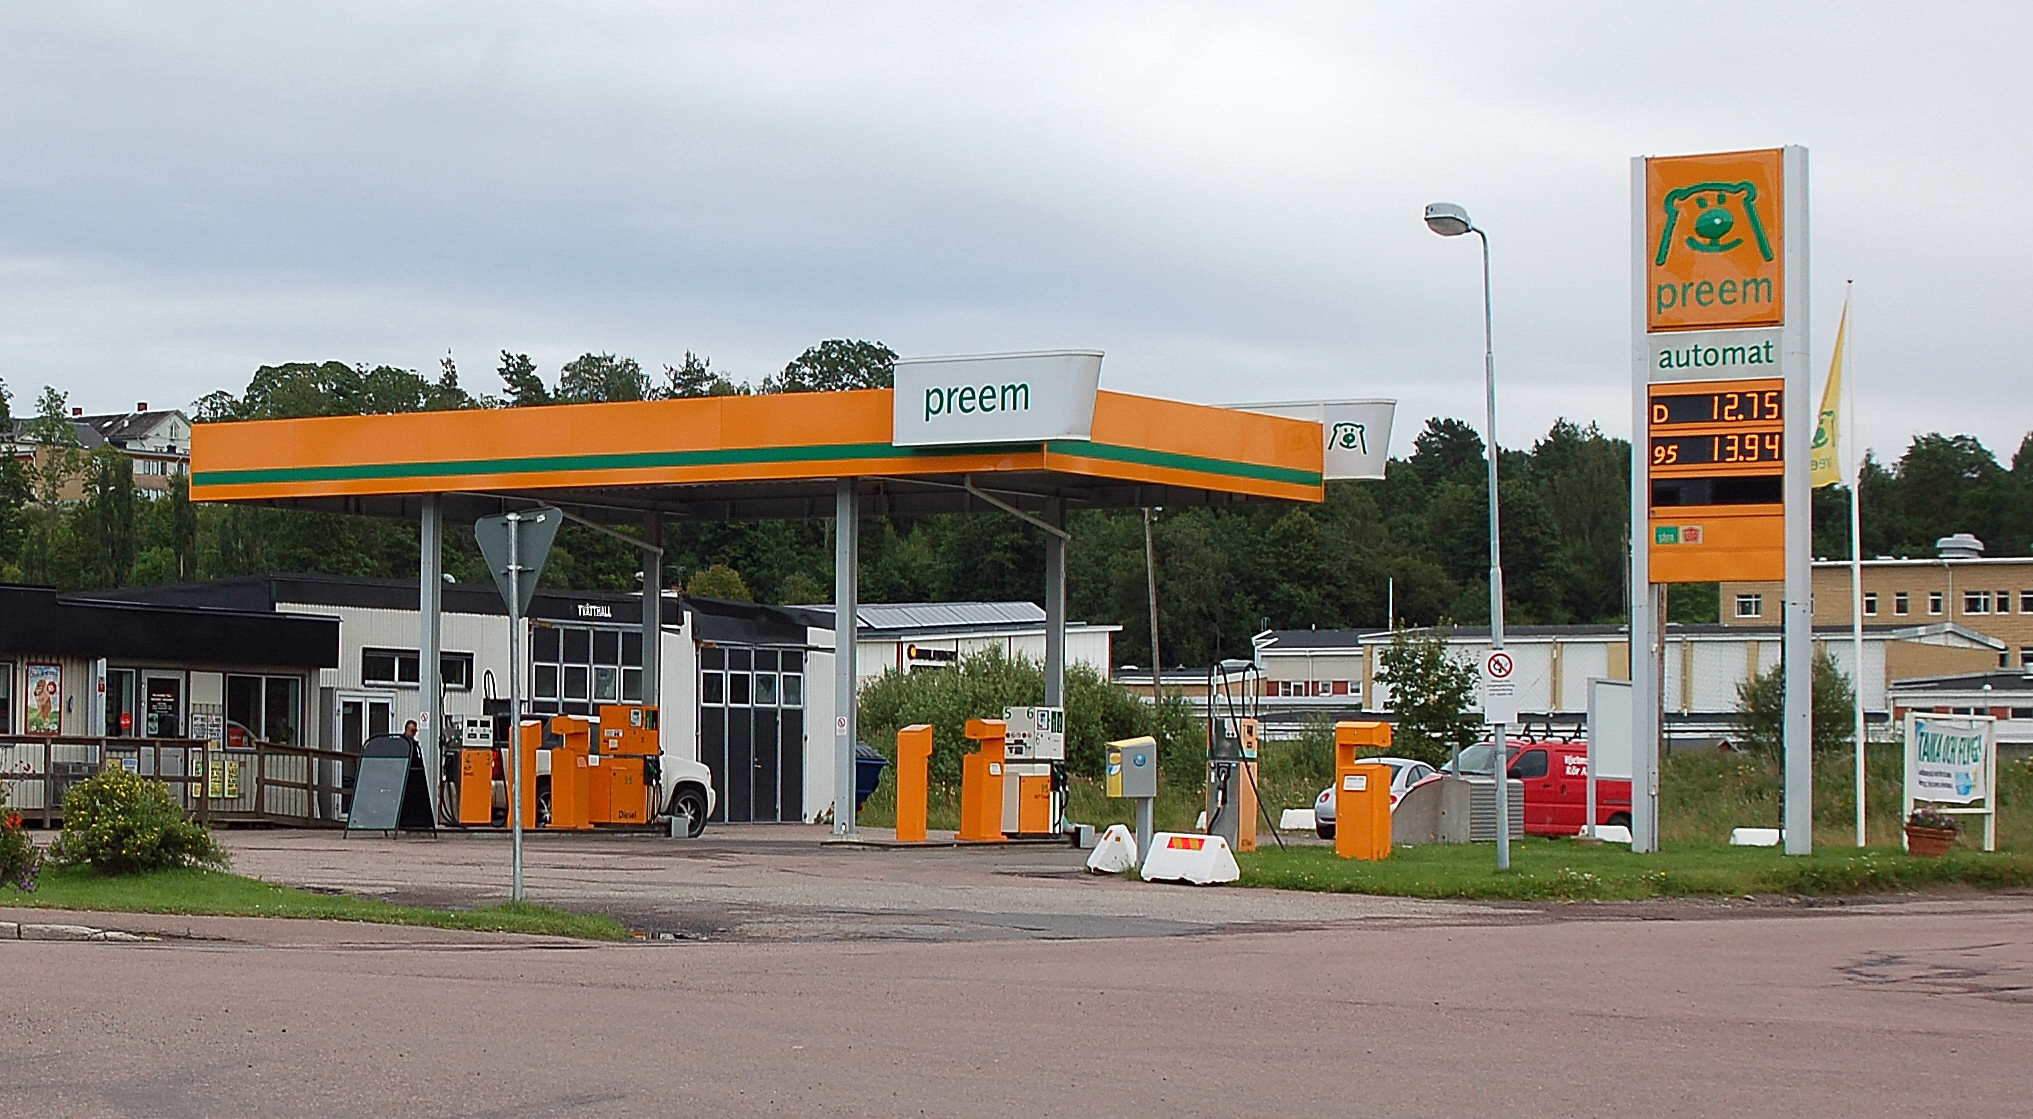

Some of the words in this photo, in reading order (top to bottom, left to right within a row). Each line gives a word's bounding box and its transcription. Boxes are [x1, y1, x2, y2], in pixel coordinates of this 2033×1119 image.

[1657, 278, 1772, 315] preem
[1659, 340, 1774, 368] automat
[925, 383, 1029, 422] preem
[1653, 404, 1669, 423] D
[1713, 391, 1779, 421] 12.75
[1653, 444, 1678, 464] 95
[1713, 434, 1780, 462] 13.94
[1004, 707, 1012, 719] 5
[1026, 707, 1034, 719] 6
[618, 810, 637, 819] Diesel
